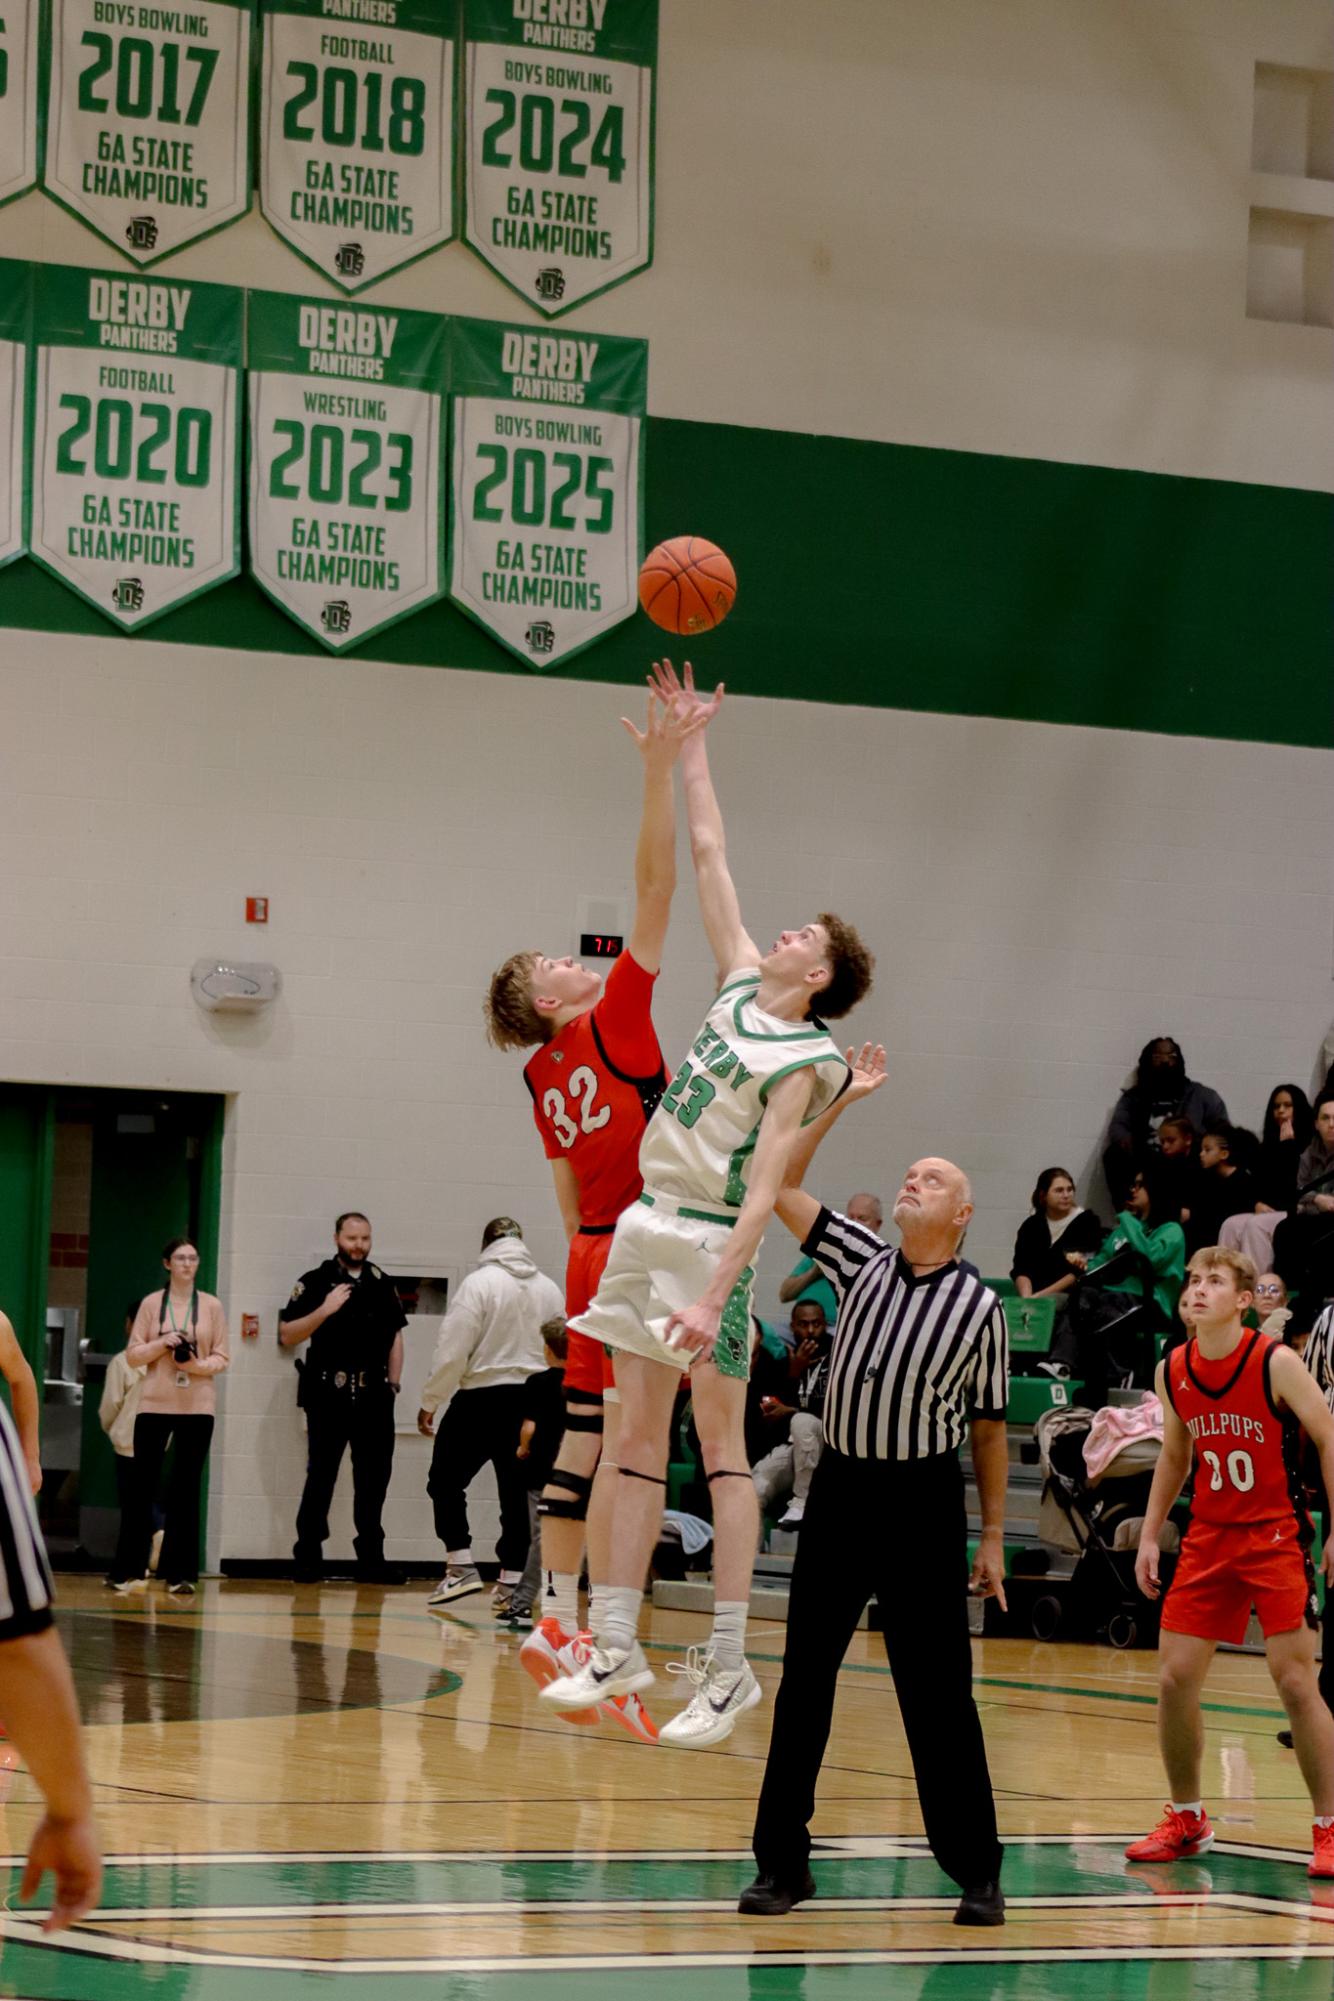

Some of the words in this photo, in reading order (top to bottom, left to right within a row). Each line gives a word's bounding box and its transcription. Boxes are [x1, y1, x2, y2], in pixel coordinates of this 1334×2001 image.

[94, 1, 134, 27] BOYS
[138, 6, 208, 37] BOWLING
[322, 0, 396, 24] PANTHERS
[321, 35, 394, 64] FOOTBALL
[523, 25, 596, 53] PANTHERS
[78, 30, 220, 127] 2017
[505, 60, 542, 85] BOYS
[546, 65, 612, 94] BOWLING
[283, 61, 426, 157] 2018
[98, 131, 125, 163] 6A
[132, 136, 193, 172] STATE
[482, 88, 626, 183] 2024
[82, 163, 207, 208] CHAMPIONS
[306, 160, 334, 191] 6A
[340, 164, 399, 200] STATE
[291, 192, 413, 235] CHAMPIONS
[507, 186, 534, 217] 6A
[541, 191, 598, 226] STATE
[492, 218, 612, 260] CHAMPIONS
[89, 278, 191, 331] DERBY
[99, 324, 177, 353] PANTHERS
[299, 305, 398, 358] DERBY
[309, 351, 384, 380] PANTHERS
[502, 332, 598, 384] DERBY
[99, 366, 175, 394] FOOTBALL
[512, 376, 585, 404] PANTHERS
[303, 391, 386, 421] WRESTLING
[56, 393, 212, 489] 2020
[495, 414, 532, 438] BOYS
[536, 419, 602, 446] BOWLING
[269, 419, 413, 512] 2023
[472, 443, 614, 534] 2025
[83, 494, 112, 525] 6A
[119, 497, 180, 533] STATE
[67, 527, 194, 568] CHAMPIONS
[292, 518, 320, 550] 6A
[328, 523, 386, 556] STATE
[277, 550, 400, 591] CHAMPIONS
[496, 541, 524, 571] 6A
[531, 545, 587, 577] STATE
[482, 573, 602, 611] CHAMPIONS
[693, 1022, 754, 1091] ERBY
[543, 1064, 611, 1149] 32
[661, 1061, 716, 1129] 23
[1186, 1413, 1265, 1443] ULLPUPS
